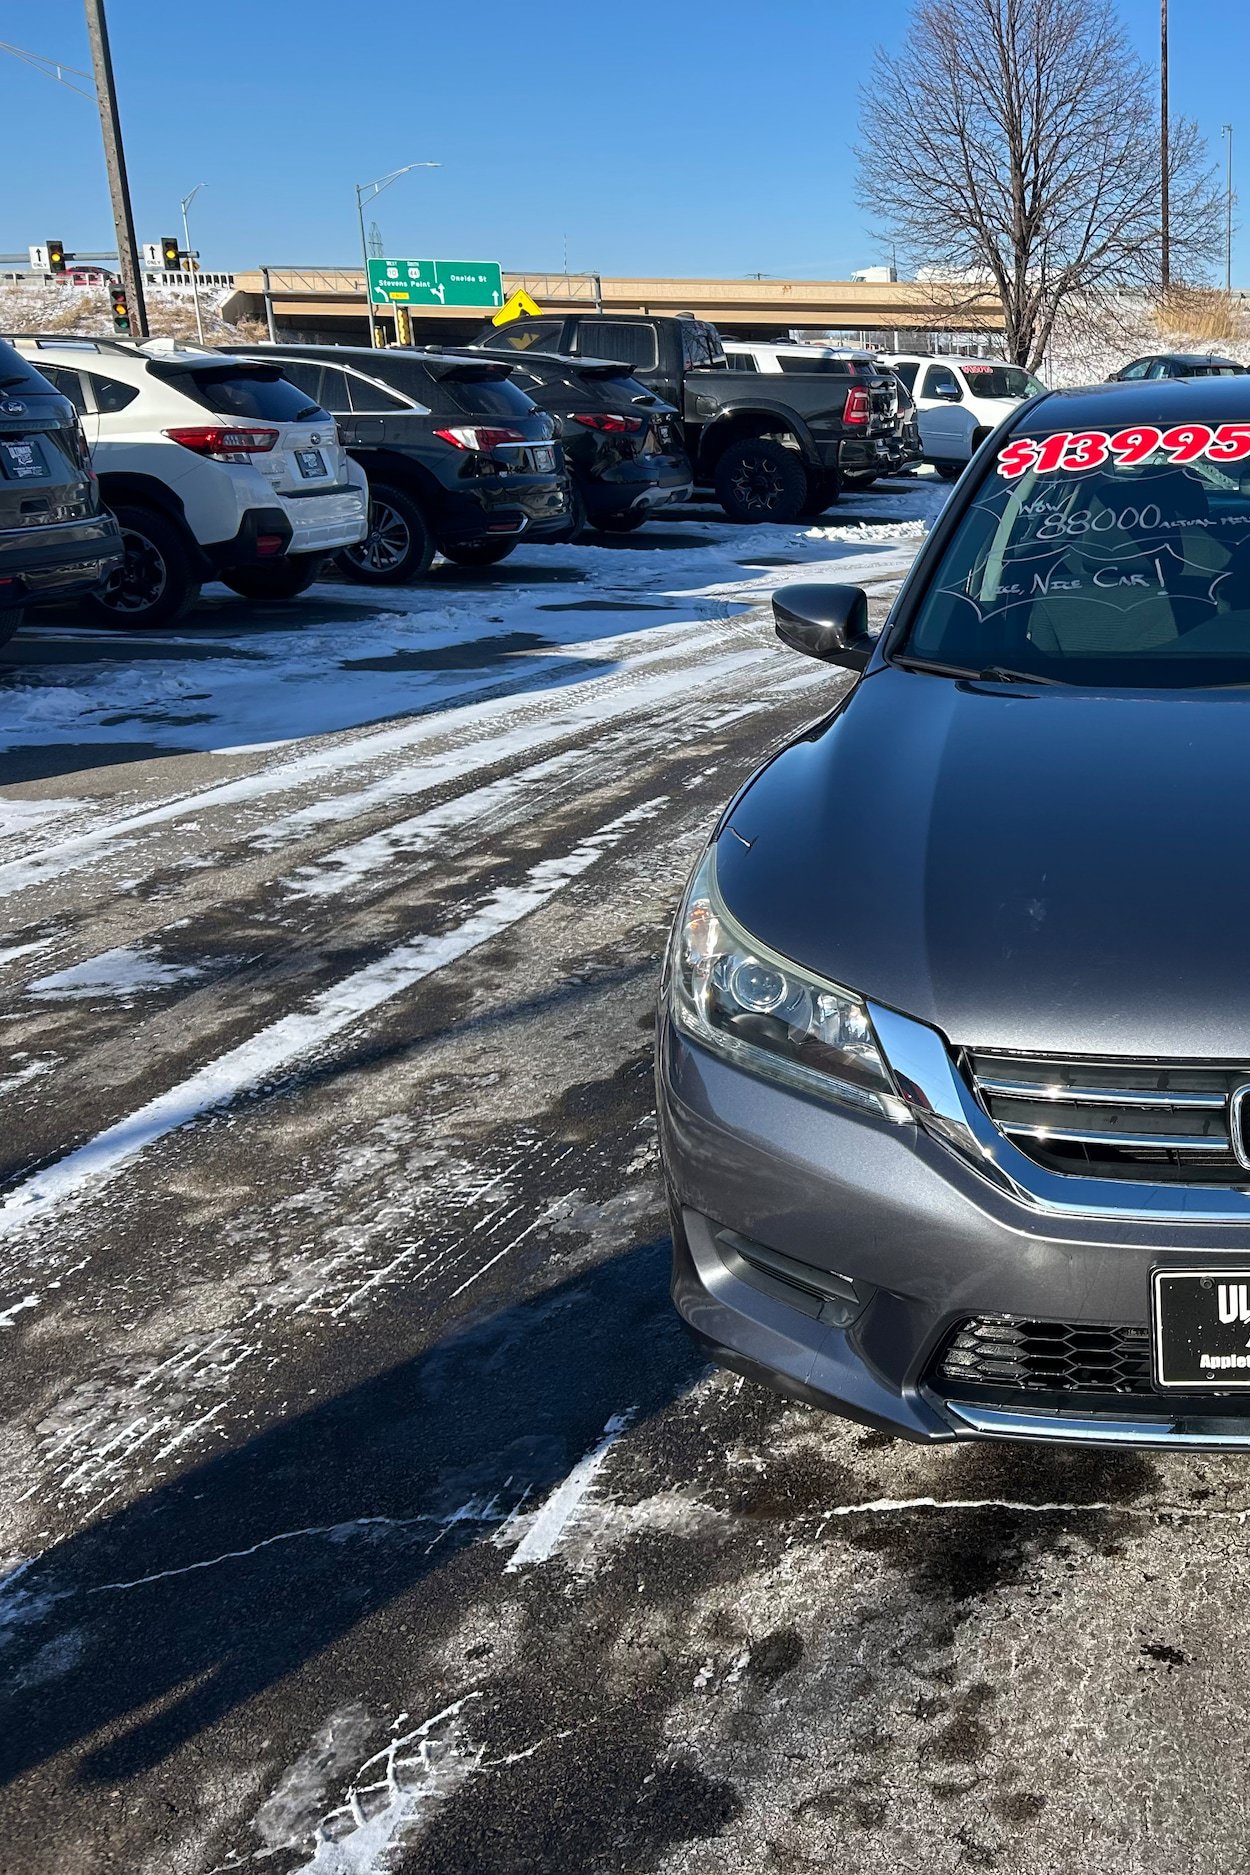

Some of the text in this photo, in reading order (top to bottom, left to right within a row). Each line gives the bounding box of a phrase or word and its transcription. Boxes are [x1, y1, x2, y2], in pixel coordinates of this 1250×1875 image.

[450, 274, 487, 283] Oneida St
[378, 279, 431, 288] Stevens Point
[1036, 503, 1161, 539] 88000
